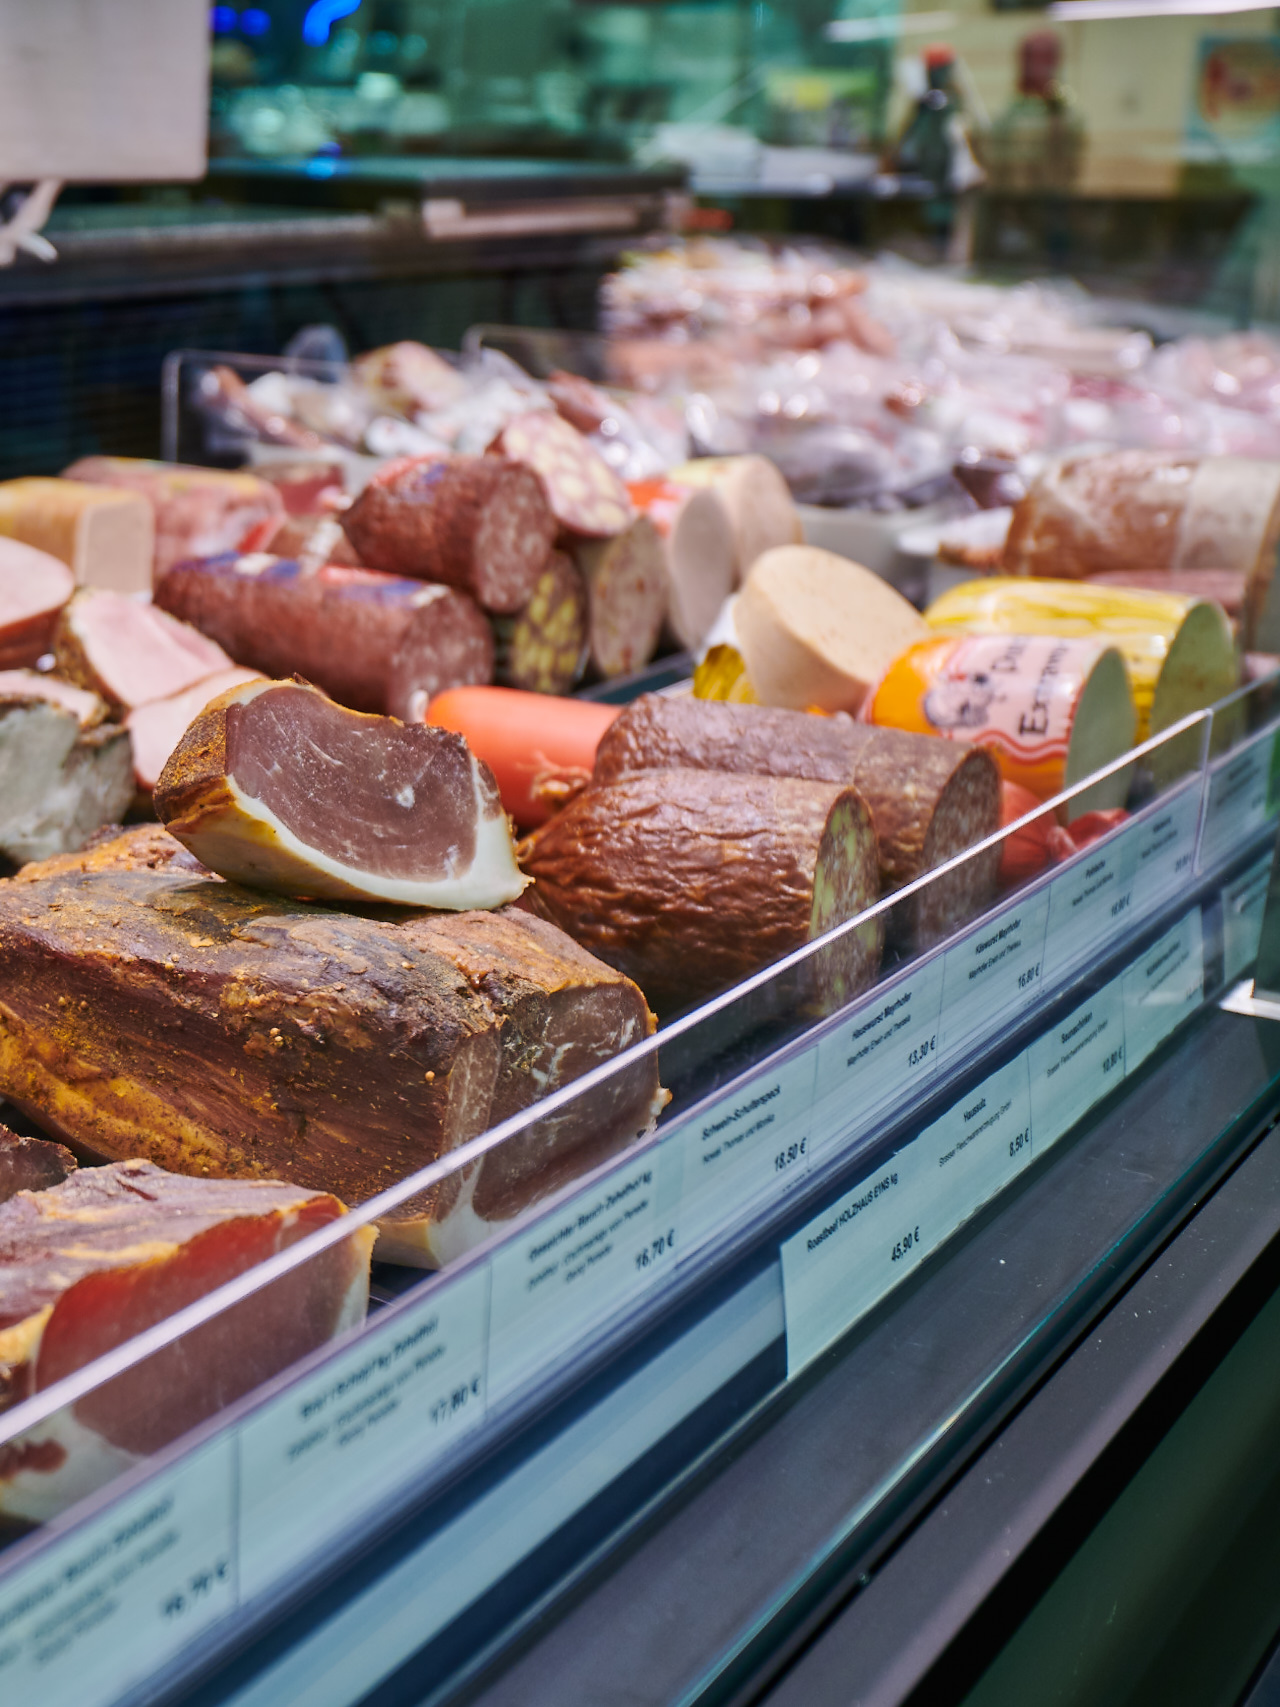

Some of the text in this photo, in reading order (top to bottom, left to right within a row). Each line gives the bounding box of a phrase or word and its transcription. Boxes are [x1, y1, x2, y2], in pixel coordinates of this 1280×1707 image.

[908, 1034, 936, 1068] 13,30 €
[775, 1136, 807, 1172] 18,50 €
[1009, 1127, 1030, 1157] 8,50 €
[807, 1217, 839, 1252] Roastbeef
[839, 1190, 873, 1227] HOLZHAUS
[890, 1171, 898, 1185] kg
[635, 1227, 675, 1271] 16,70 €
[891, 1225, 920, 1261] 45,90 €
[471, 1372, 481, 1396] €
